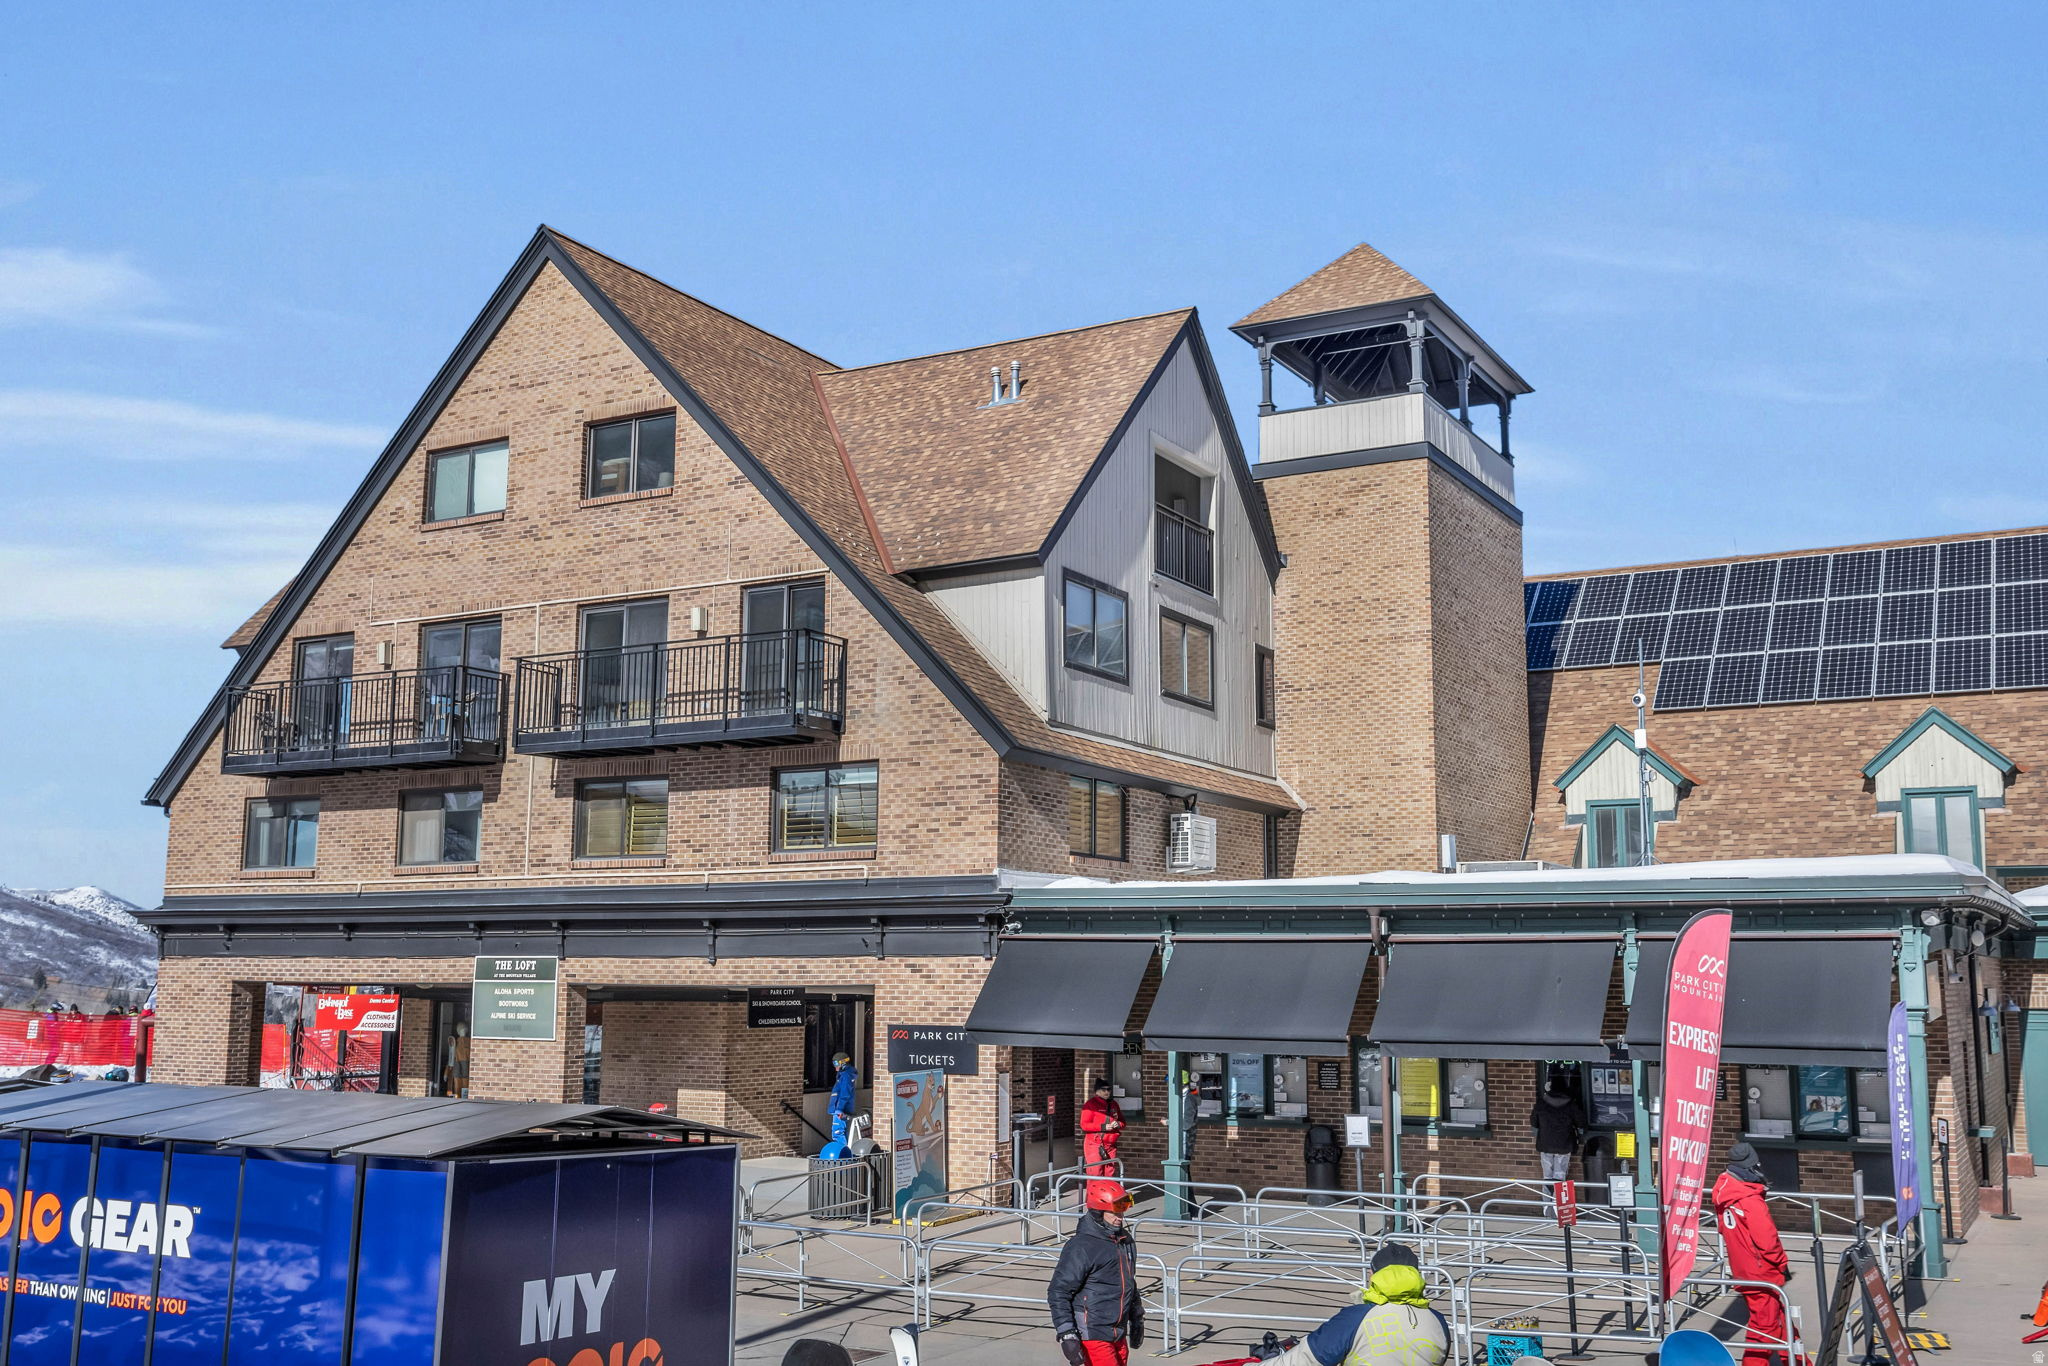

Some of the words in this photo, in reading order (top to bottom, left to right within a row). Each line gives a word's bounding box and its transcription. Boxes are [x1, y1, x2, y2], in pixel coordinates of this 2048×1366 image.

[495, 961, 512, 970] THE
[515, 961, 536, 970] LOFT
[1674, 971, 1700, 987] PARK
[1702, 980, 1724, 993] CITY
[1673, 983, 1723, 1003] MOUNTAIN
[914, 1032, 942, 1040] PARK
[946, 1032, 968, 1040] CIT
[909, 1054, 955, 1066] TICKETS
[30, 1280, 58, 1298] THAN
[110, 1292, 137, 1309] JUST
[162, 1298, 186, 1315] YOU
[520, 1268, 617, 1346] MY
